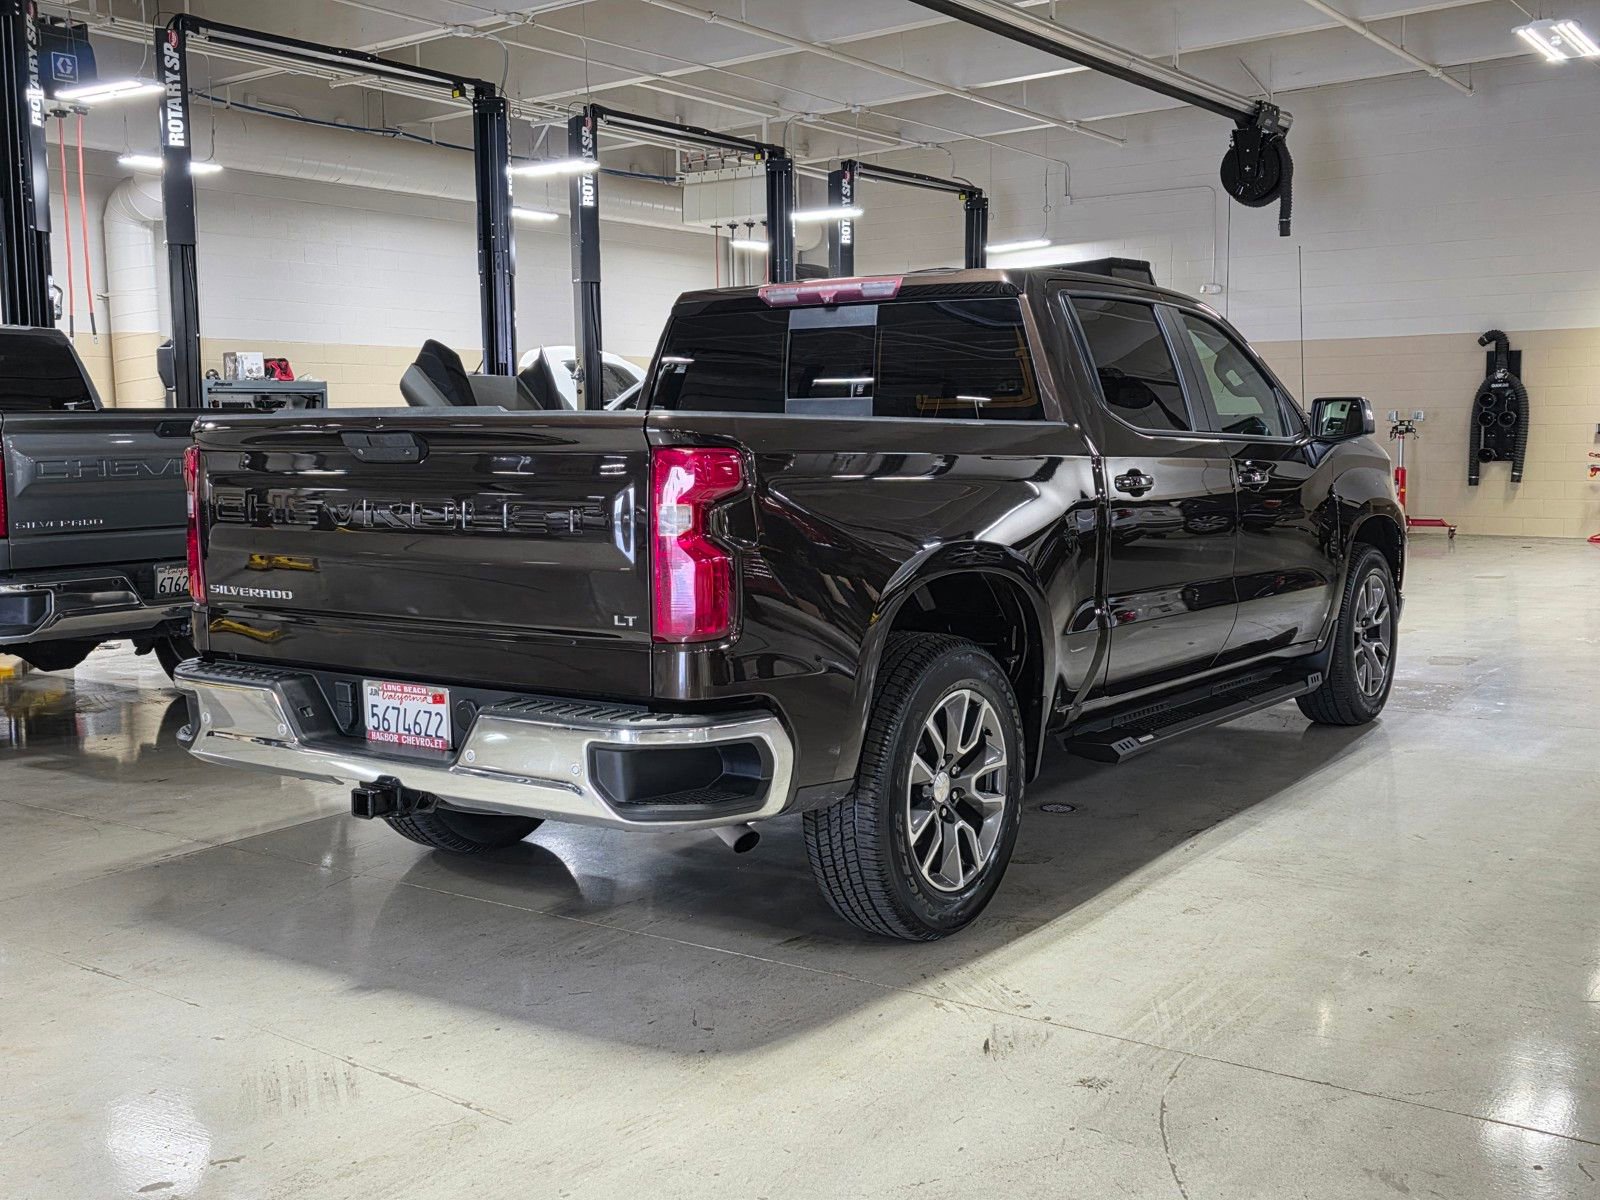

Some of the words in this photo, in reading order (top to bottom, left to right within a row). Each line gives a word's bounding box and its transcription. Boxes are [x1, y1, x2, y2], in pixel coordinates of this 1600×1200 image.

[165, 71, 184, 147] ROTARY
[215, 494, 607, 534] CHEVROLET
[15, 518, 103, 530] SILVERADO
[210, 584, 293, 600] SILVERADO
[614, 615, 637, 627] LT
[383, 684, 402, 692] LONG
[403, 686, 427, 695] BEACH
[371, 703, 444, 738] 56746Z2
[371, 731, 399, 743] HARBOR
[401, 735, 443, 749] CHEVROLET
